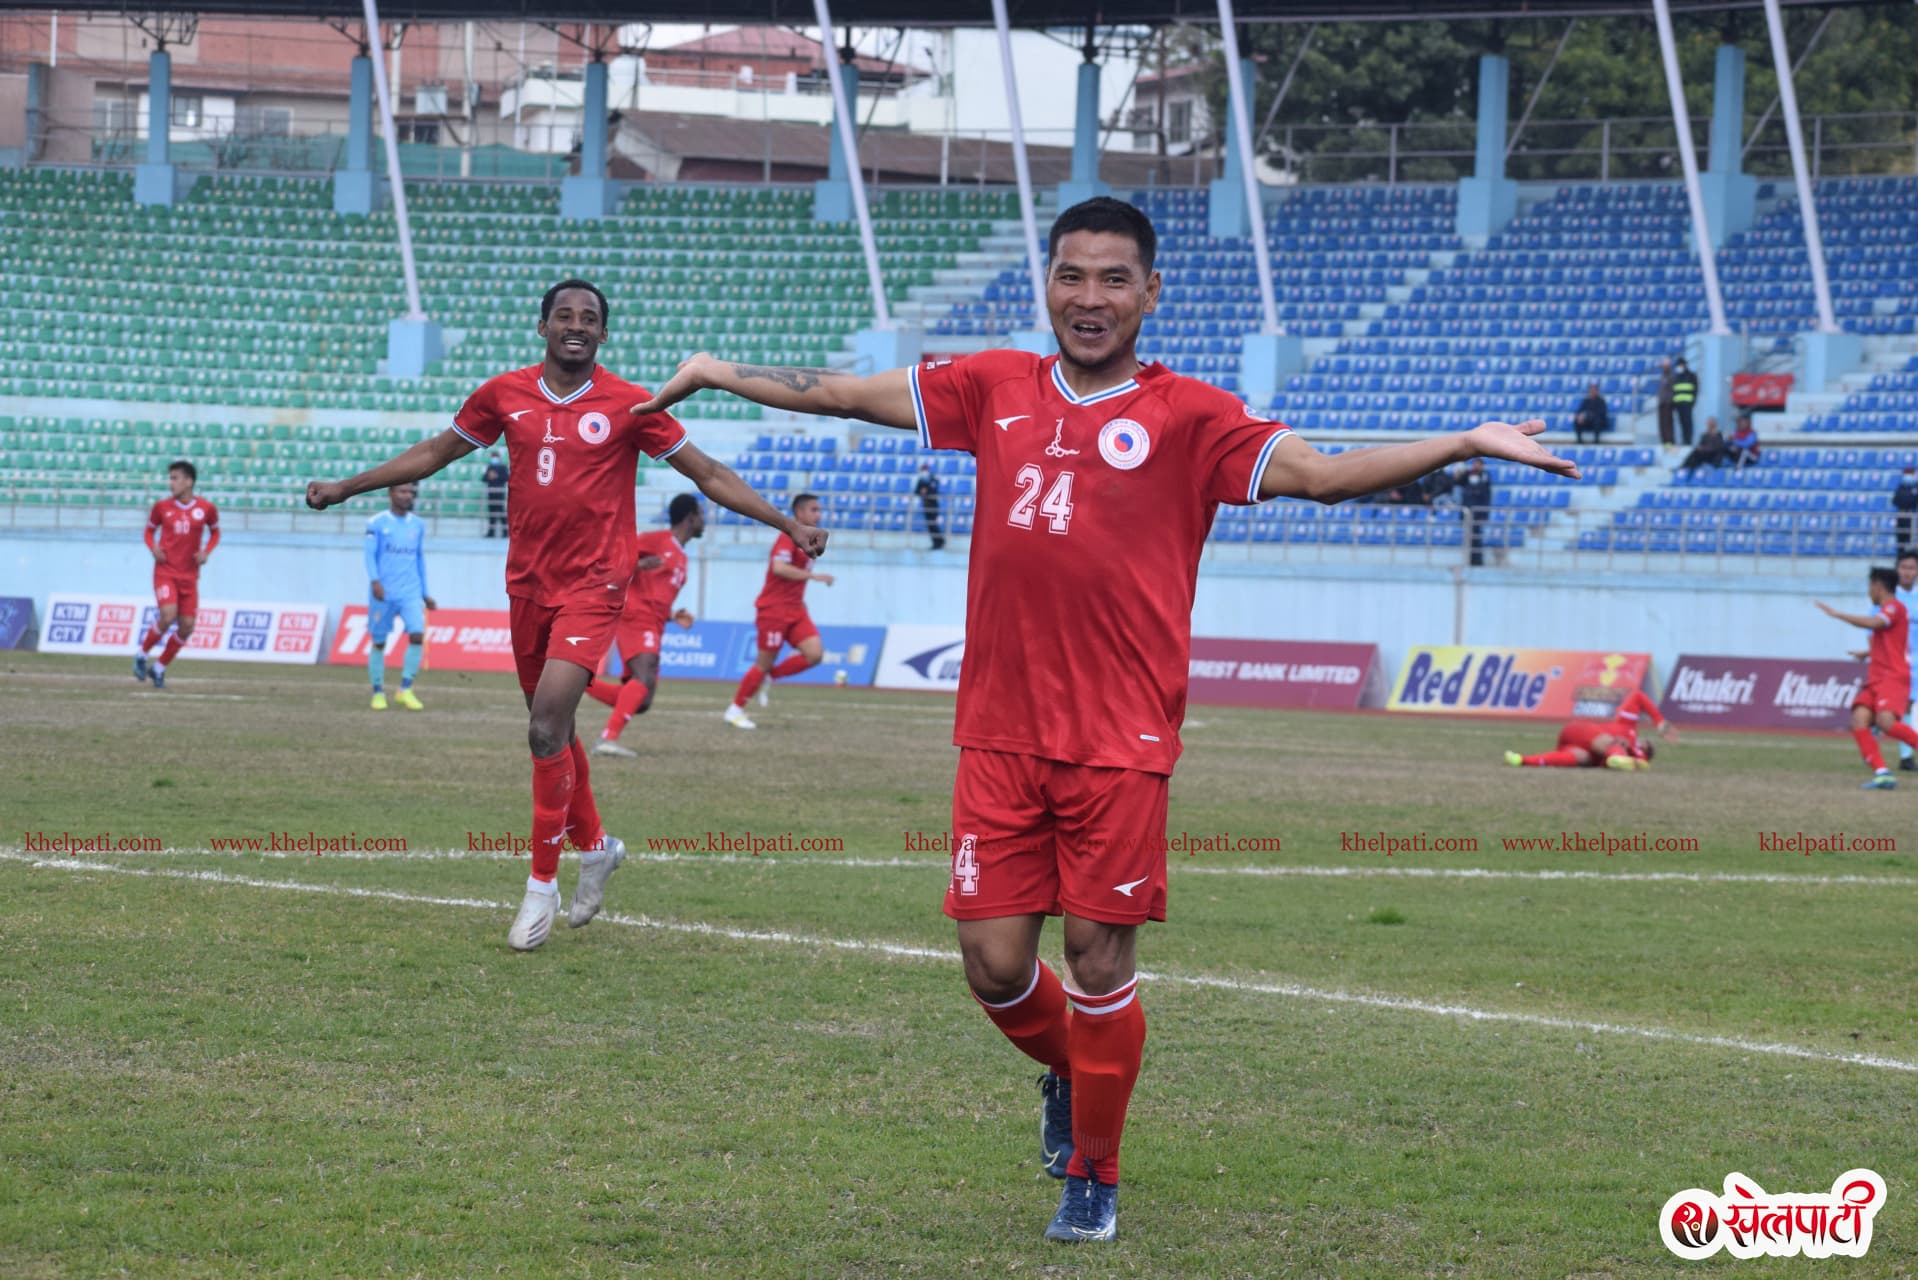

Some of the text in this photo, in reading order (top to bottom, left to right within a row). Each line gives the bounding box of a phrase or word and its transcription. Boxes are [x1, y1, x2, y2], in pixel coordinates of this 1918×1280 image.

[536, 446, 557, 486] 9
[1007, 463, 1075, 535] 24
[54, 605, 87, 621] KTM
[99, 606, 132, 622] KTM
[196, 611, 223, 626] TM
[236, 612, 270, 628] KTM
[282, 614, 315, 630] KTM
[51, 626, 84, 642] CTY
[95, 628, 128, 644] CTY
[231, 633, 264, 649] CTY
[276, 635, 309, 651] CTY
[1238, 662, 1288, 682] BANK
[1288, 664, 1360, 685] LIMITED
[1399, 652, 1474, 705] Red
[1467, 653, 1547, 709] Blue
[1671, 666, 1758, 704] Khukri
[1774, 671, 1862, 708] Khukri
